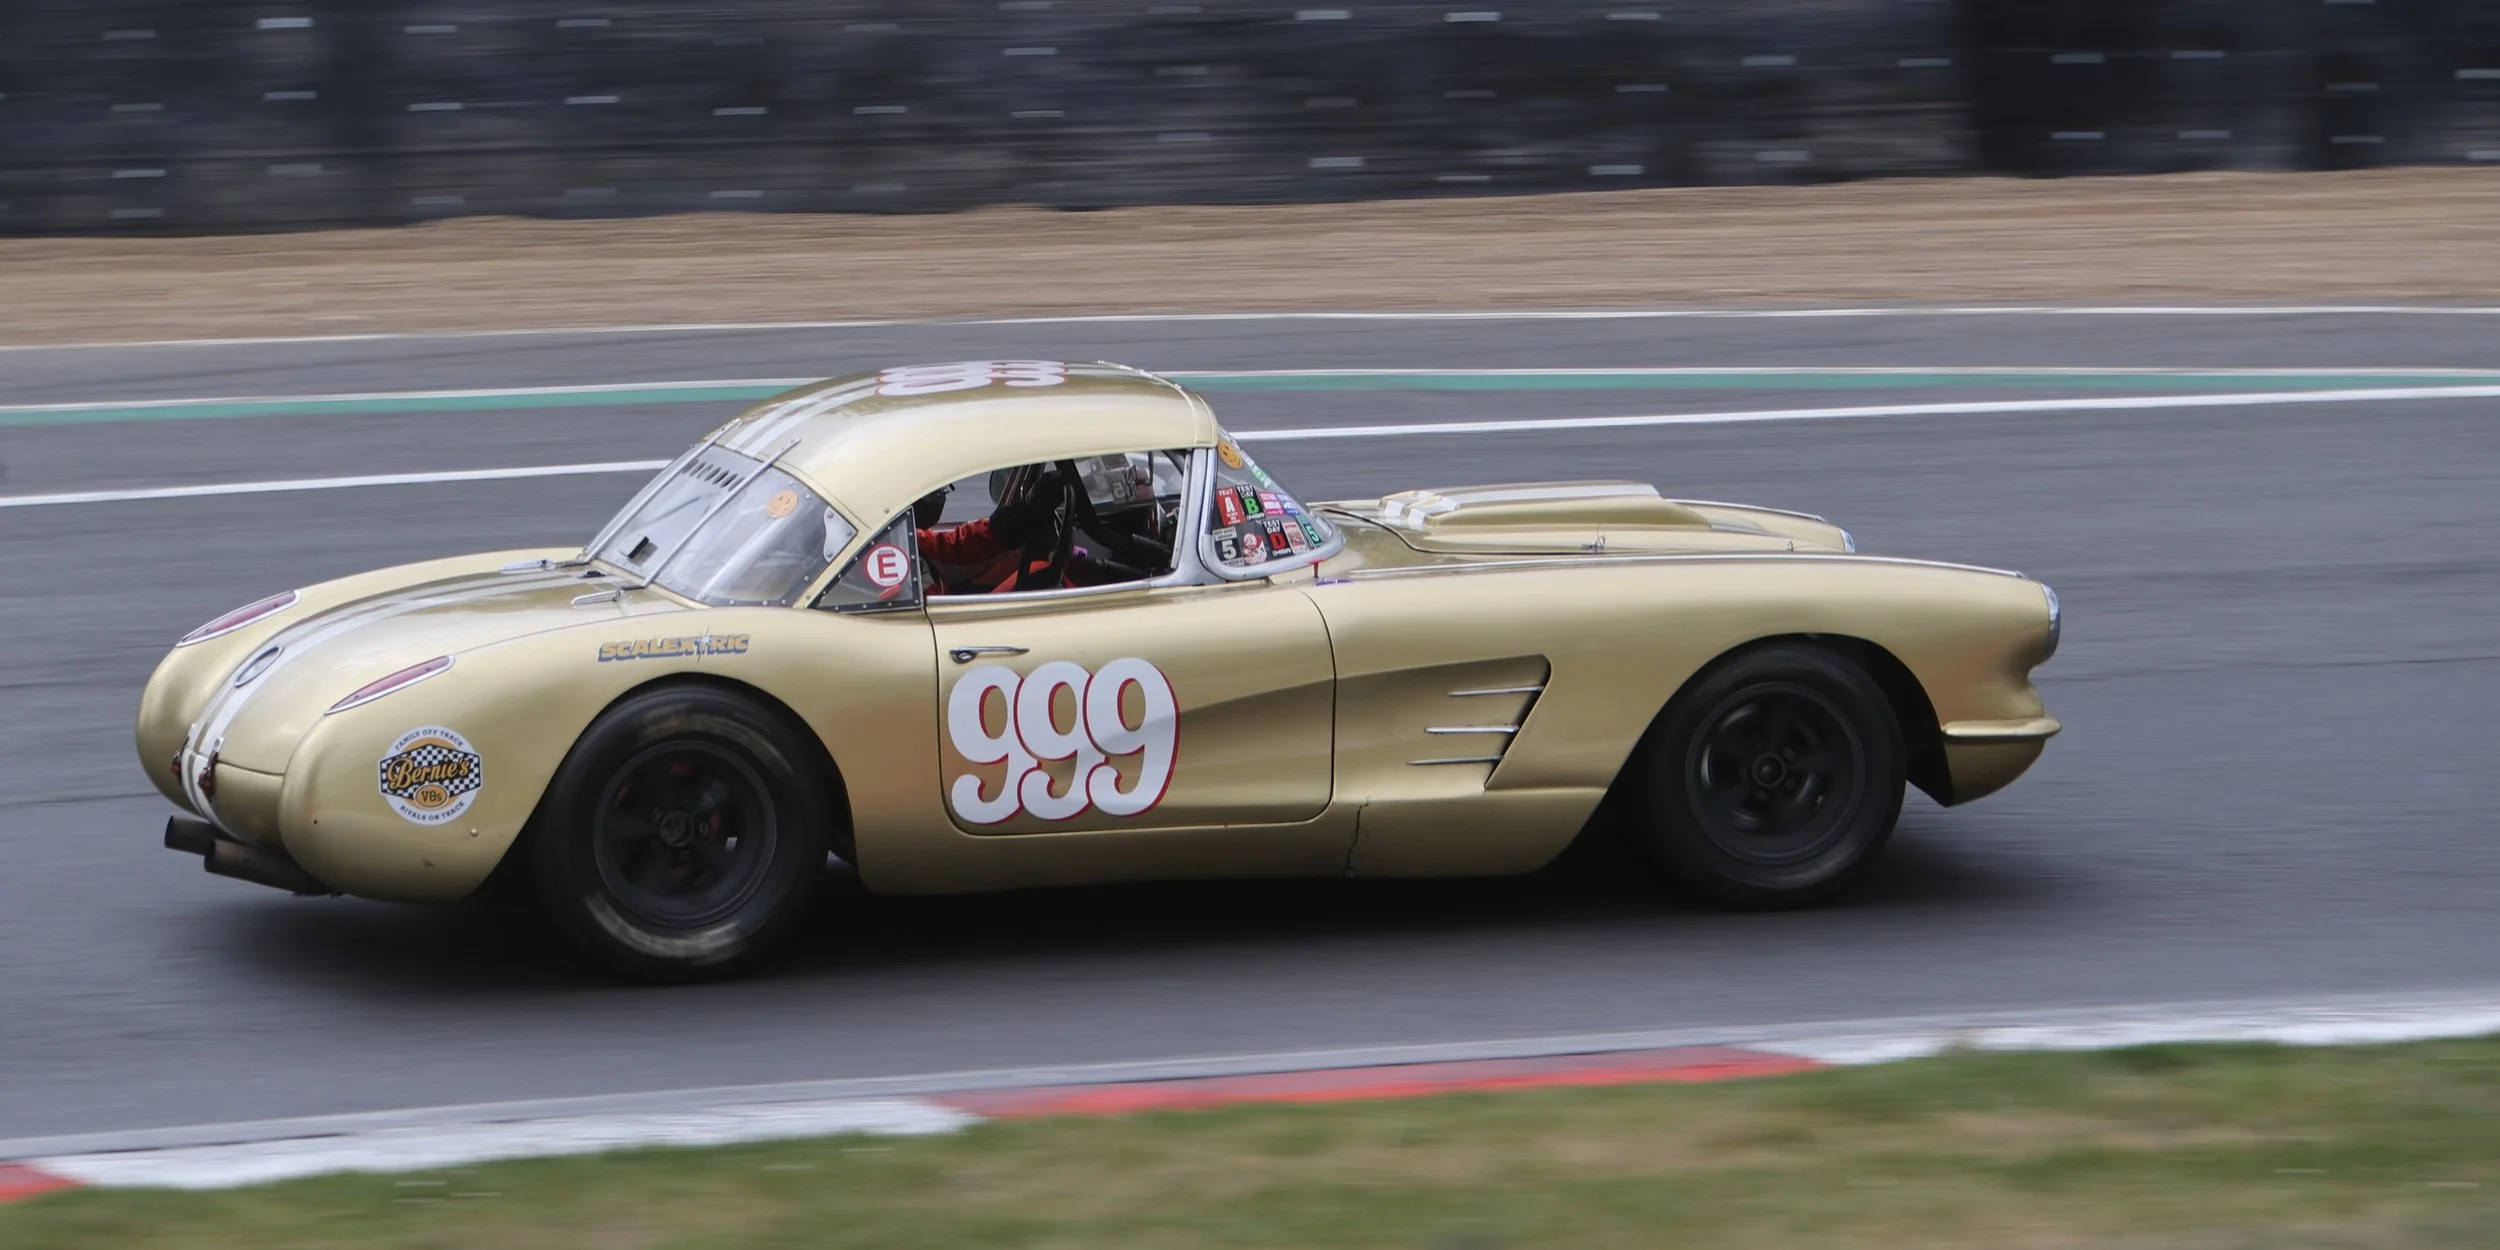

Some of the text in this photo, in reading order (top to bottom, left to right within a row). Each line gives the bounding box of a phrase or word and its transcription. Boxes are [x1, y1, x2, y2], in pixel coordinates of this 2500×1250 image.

[1224, 496, 1236, 512] A
[1244, 498, 1259, 515] B
[1263, 519, 1280, 528] TEST
[1267, 526, 1280, 534] DAY
[1270, 533, 1286, 550] D
[1305, 525, 1319, 543] 5
[1222, 540, 1236, 559] 5
[877, 553, 898, 579] E
[395, 730, 420, 751] FAMILY
[440, 730, 464, 747] TRACK
[948, 657, 1180, 825] 999
[387, 756, 470, 789] Bernie's
[400, 805, 426, 820] RIVALS
[442, 801, 465, 818] TRACK
